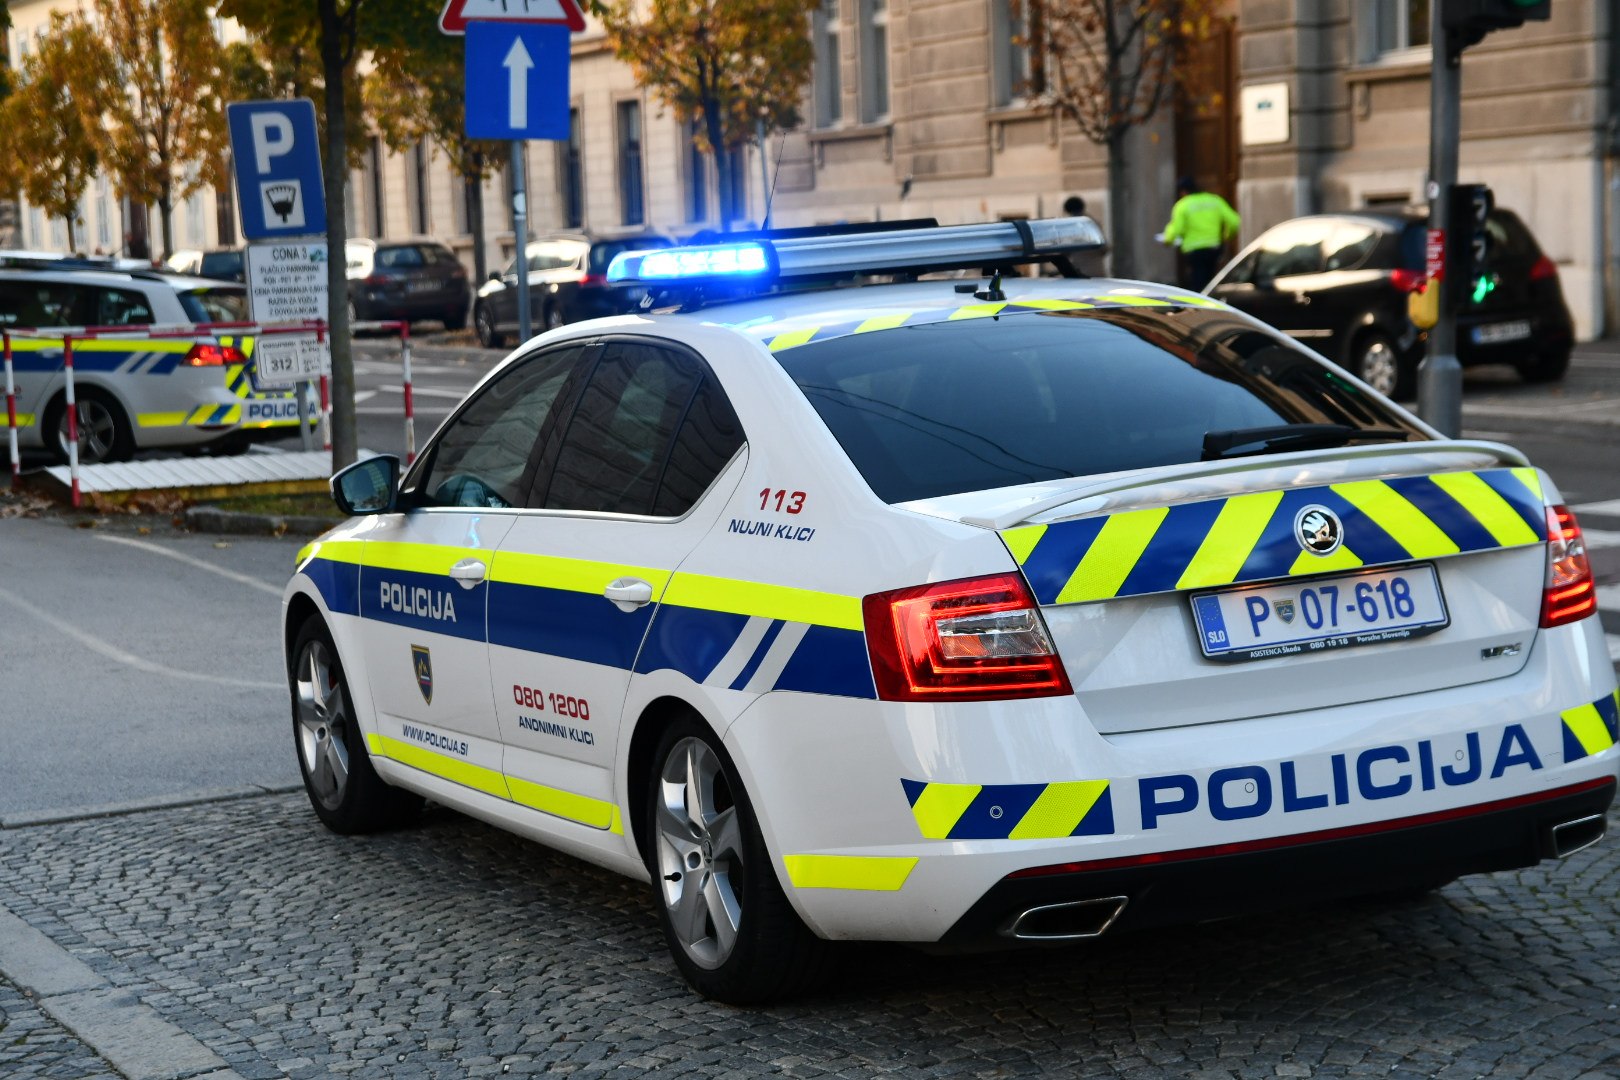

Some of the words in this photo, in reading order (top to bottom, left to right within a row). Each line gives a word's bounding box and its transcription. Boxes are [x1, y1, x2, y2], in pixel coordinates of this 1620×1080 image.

[250, 111, 295, 175] P
[272, 247, 300, 261] CONA
[302, 247, 308, 259] 3
[271, 358, 293, 371] 312
[249, 402, 316, 418] POLICA
[759, 487, 807, 515] 113
[727, 518, 774, 537] NUJNI
[774, 524, 816, 542] KLICI
[380, 580, 457, 623] POLICIJA
[1244, 595, 1270, 638] P
[1299, 576, 1416, 630] 07-618
[1208, 630, 1226, 643] SLO
[1250, 647, 1281, 658] ASISTENCA
[1309, 641, 1325, 649] 080
[1327, 639, 1337, 647] 19
[1338, 637, 1349, 645] 18
[1356, 633, 1381, 643] Porsche
[513, 684, 545, 711] 080
[549, 692, 590, 721] 1200
[402, 723, 469, 756] WWW.POLICIJA.SI
[518, 715, 568, 739] ANONIMNI
[569, 728, 595, 746] KLICI
[1138, 723, 1544, 830] POLICIJA
